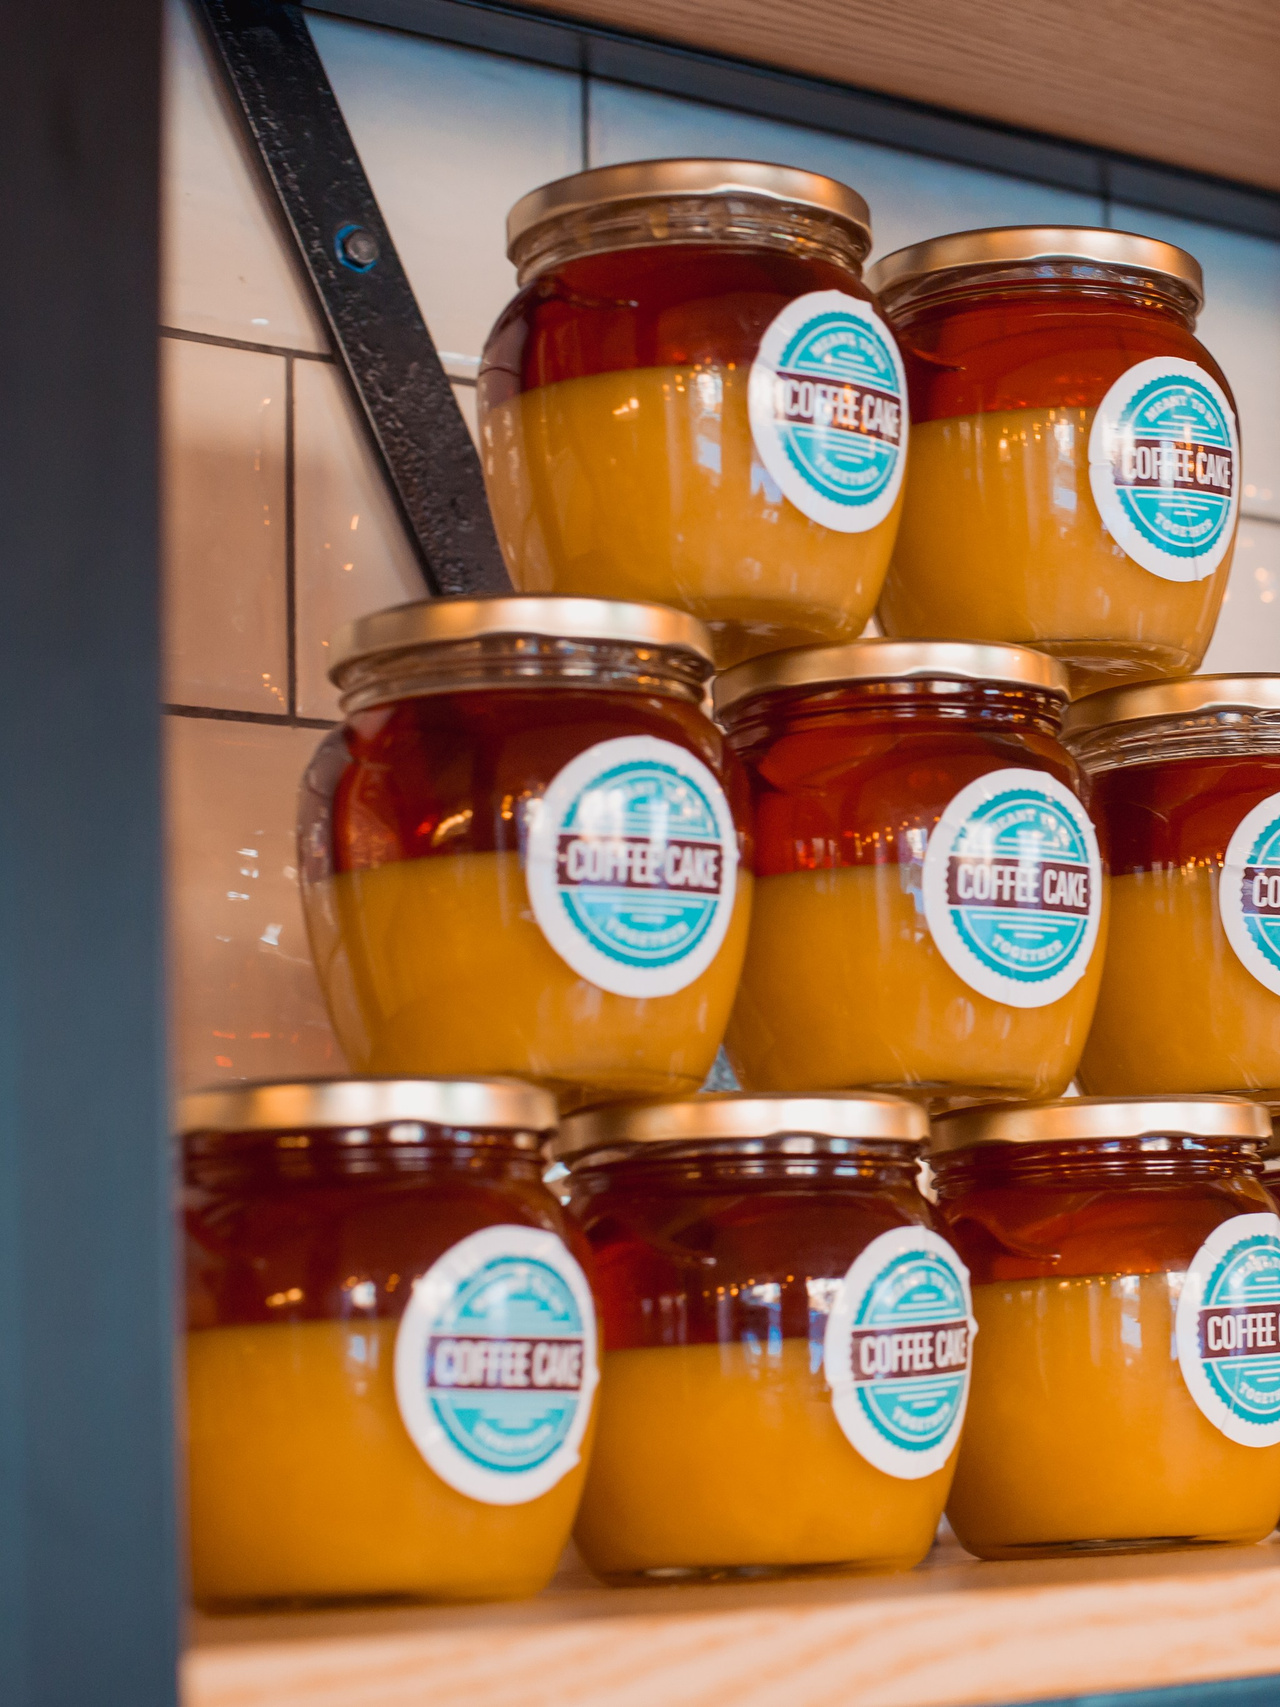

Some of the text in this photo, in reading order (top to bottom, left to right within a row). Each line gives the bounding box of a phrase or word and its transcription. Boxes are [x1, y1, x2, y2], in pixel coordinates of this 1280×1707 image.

[784, 378, 901, 438] COFFEE CAKE
[1143, 394, 1188, 423] MEANT
[1121, 446, 1232, 489] COFFEE CAKE
[566, 840, 719, 889] COFFEE CAKE
[957, 863, 1088, 908] COFFEE CAKE
[991, 933, 1065, 962] TOGETHER
[859, 1327, 969, 1375] COFFEE CAKE
[1207, 1312, 1277, 1351] COFFEE
[433, 1340, 582, 1389] COFFEE CAKE
